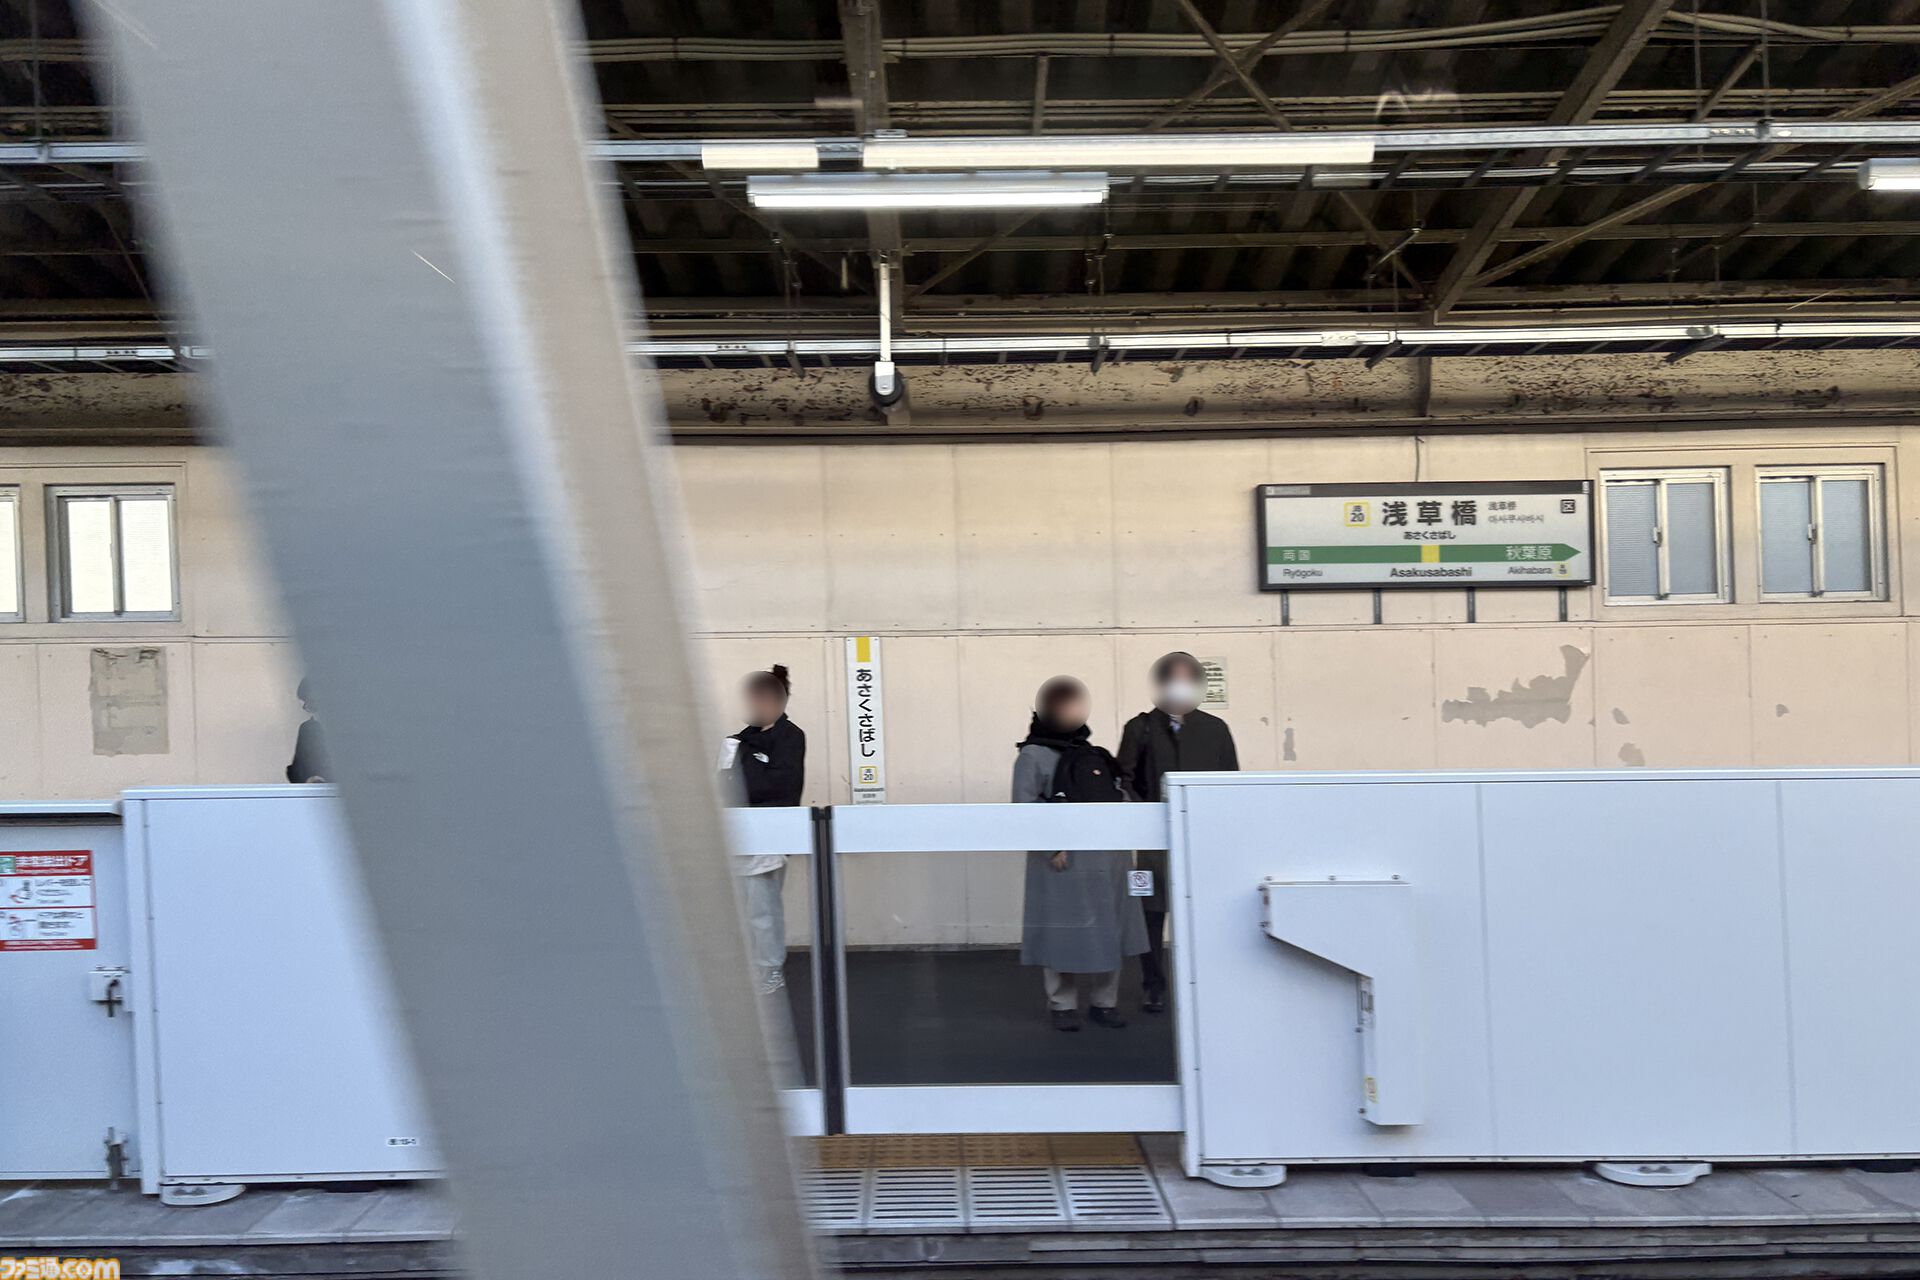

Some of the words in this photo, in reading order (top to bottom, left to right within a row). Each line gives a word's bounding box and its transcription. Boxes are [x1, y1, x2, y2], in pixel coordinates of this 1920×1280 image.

[1350, 512, 1365, 522] 20
[1382, 500, 1477, 526] 浅草橋
[1403, 530, 1456, 540] あさくさばし
[1505, 545, 1552, 560] 秋葉原
[1390, 566, 1472, 577] Asakusabashi
[856, 668, 876, 758] あさくさばし
